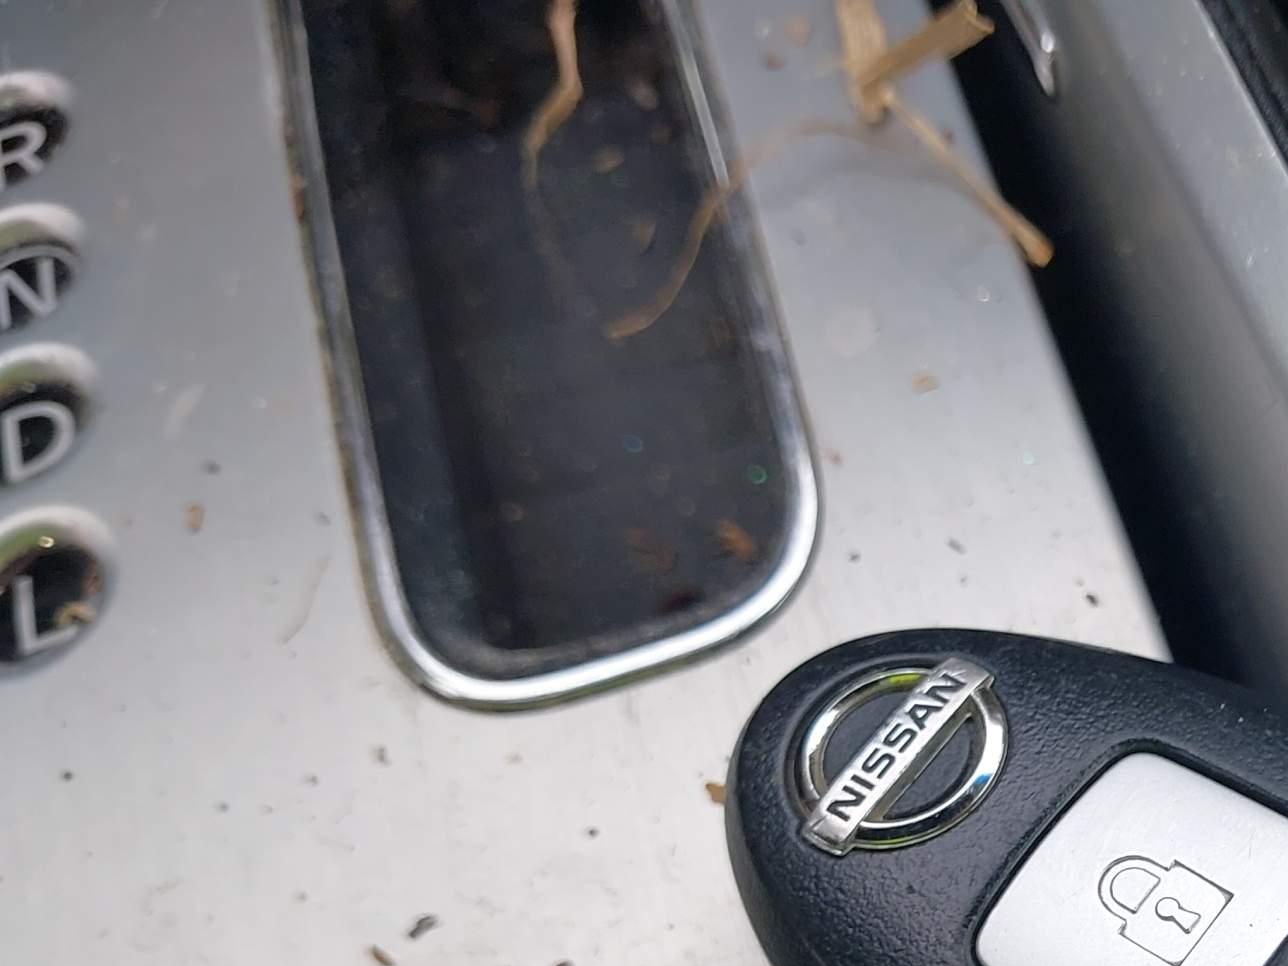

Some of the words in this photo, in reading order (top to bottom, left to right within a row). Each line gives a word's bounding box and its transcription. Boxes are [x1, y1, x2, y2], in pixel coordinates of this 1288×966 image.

[0, 120, 47, 191] R
[0, 256, 57, 330] N
[2, 399, 77, 483] D
[13, 573, 80, 656] L
[825, 670, 969, 822] NISSAN
